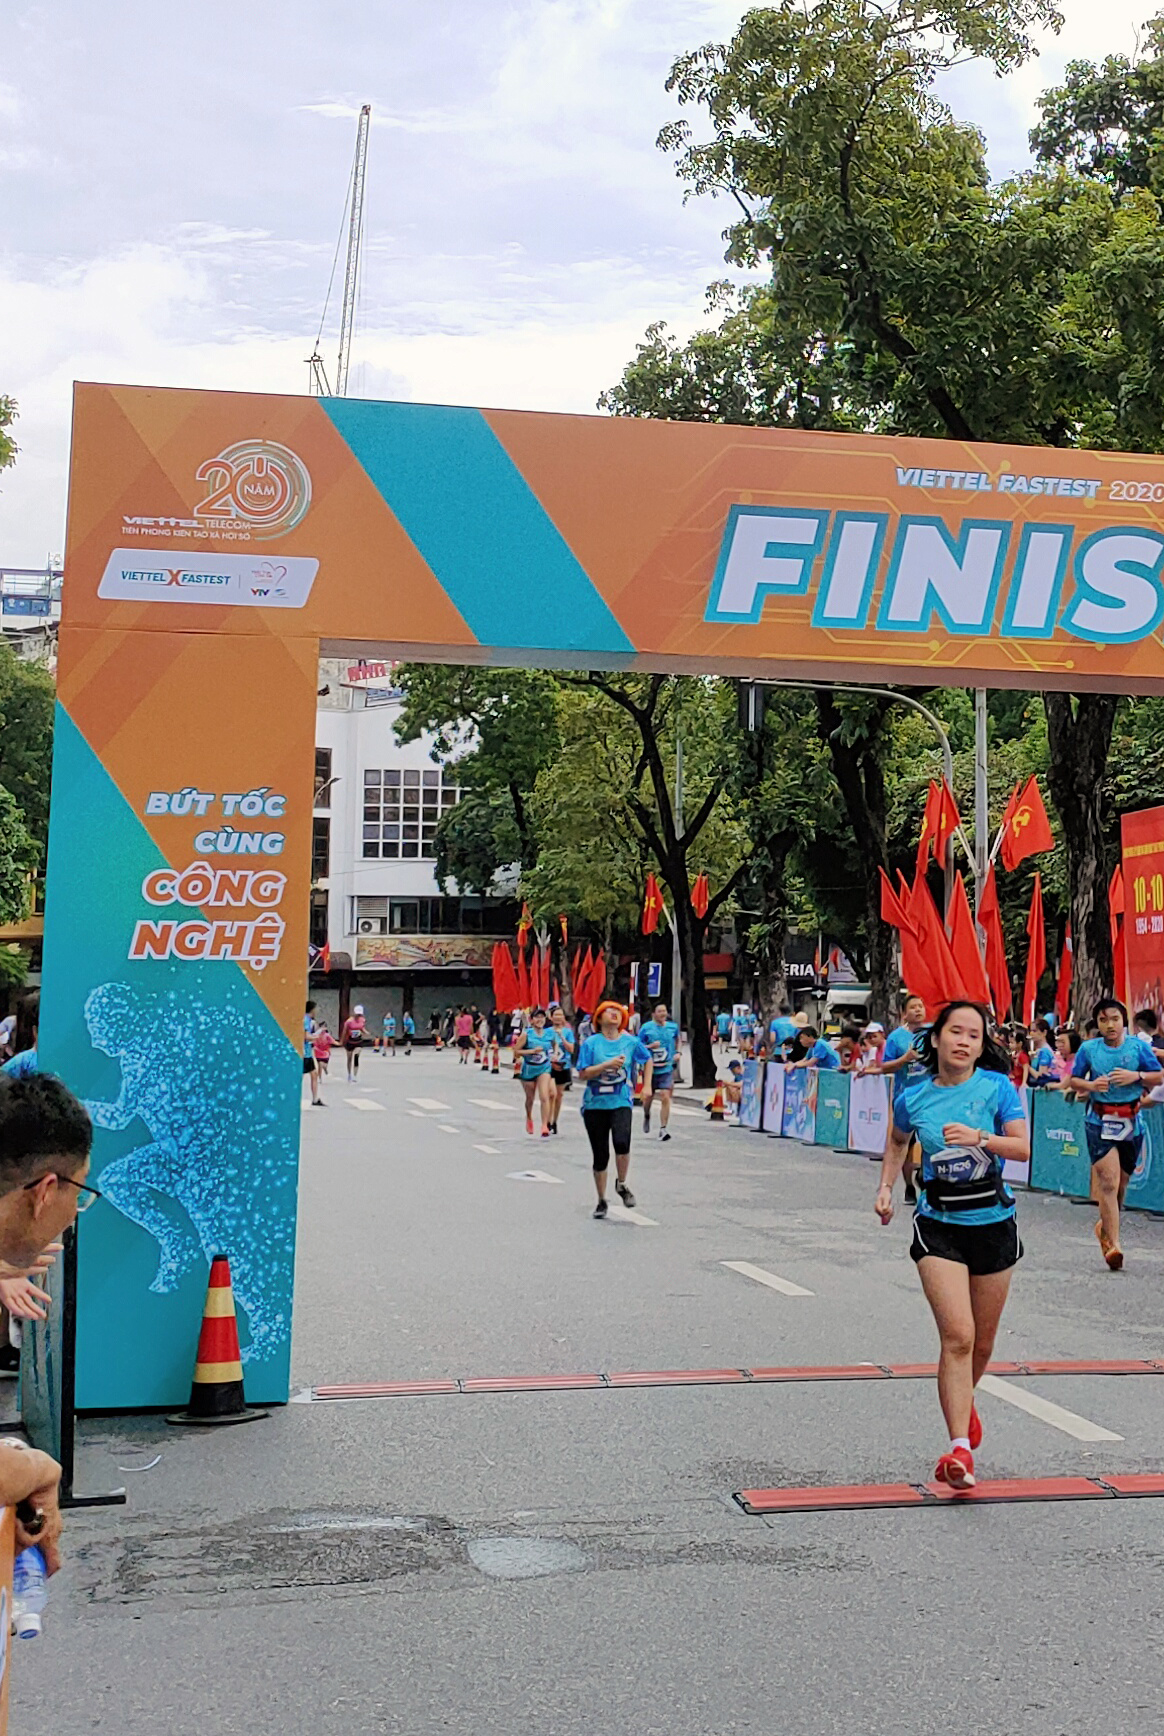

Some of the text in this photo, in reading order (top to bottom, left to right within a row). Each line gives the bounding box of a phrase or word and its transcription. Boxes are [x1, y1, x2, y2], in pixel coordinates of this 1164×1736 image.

[896, 467, 993, 490] VIETTEL
[998, 475, 1102, 498] FASTEST
[122, 515, 251, 531] VIETTEL TELECOM
[121, 571, 166, 582] VIETTEL
[181, 573, 231, 585] FASTEST
[146, 787, 287, 817] BỨT TỐC
[194, 826, 286, 855] CÙNG
[142, 861, 288, 907] CÔNG
[128, 912, 286, 970] NGHỆ
